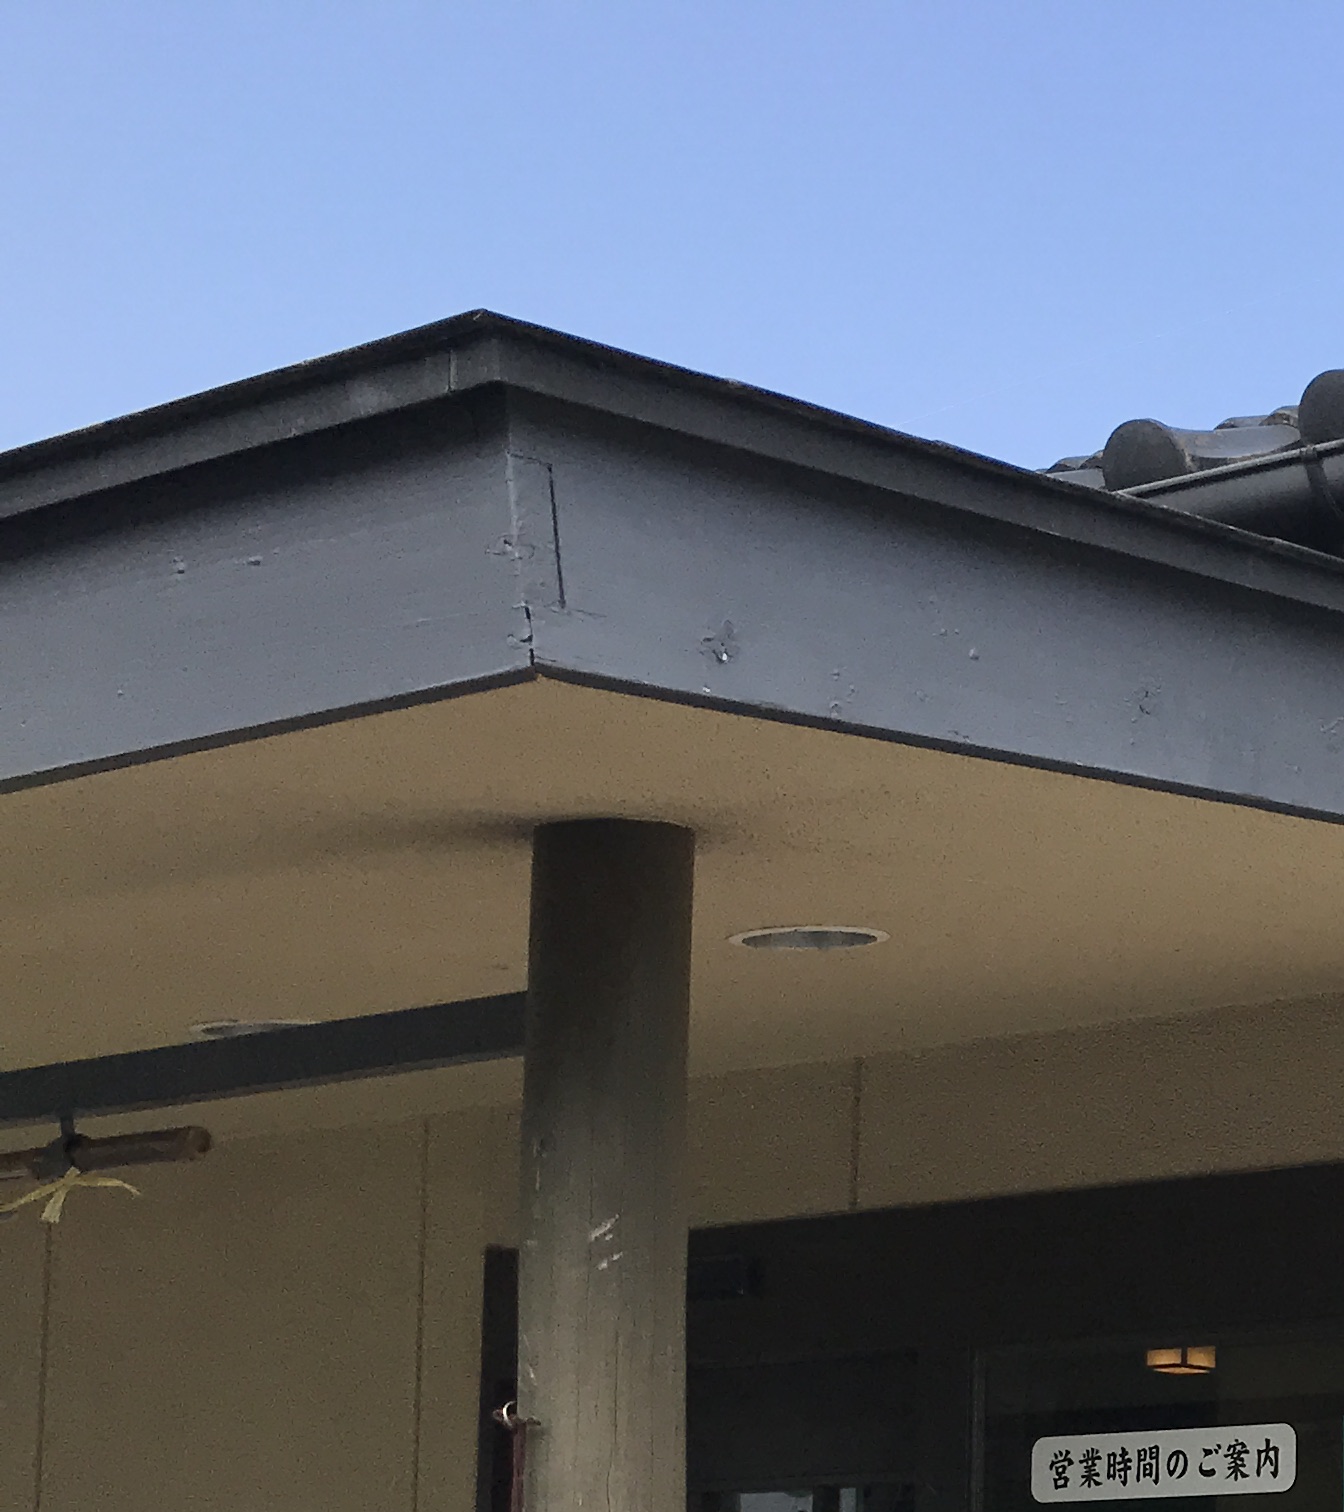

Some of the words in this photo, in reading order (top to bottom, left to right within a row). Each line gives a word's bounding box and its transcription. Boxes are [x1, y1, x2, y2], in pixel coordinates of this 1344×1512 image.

[1048, 1438, 1281, 1489] 営業時間のご案内
